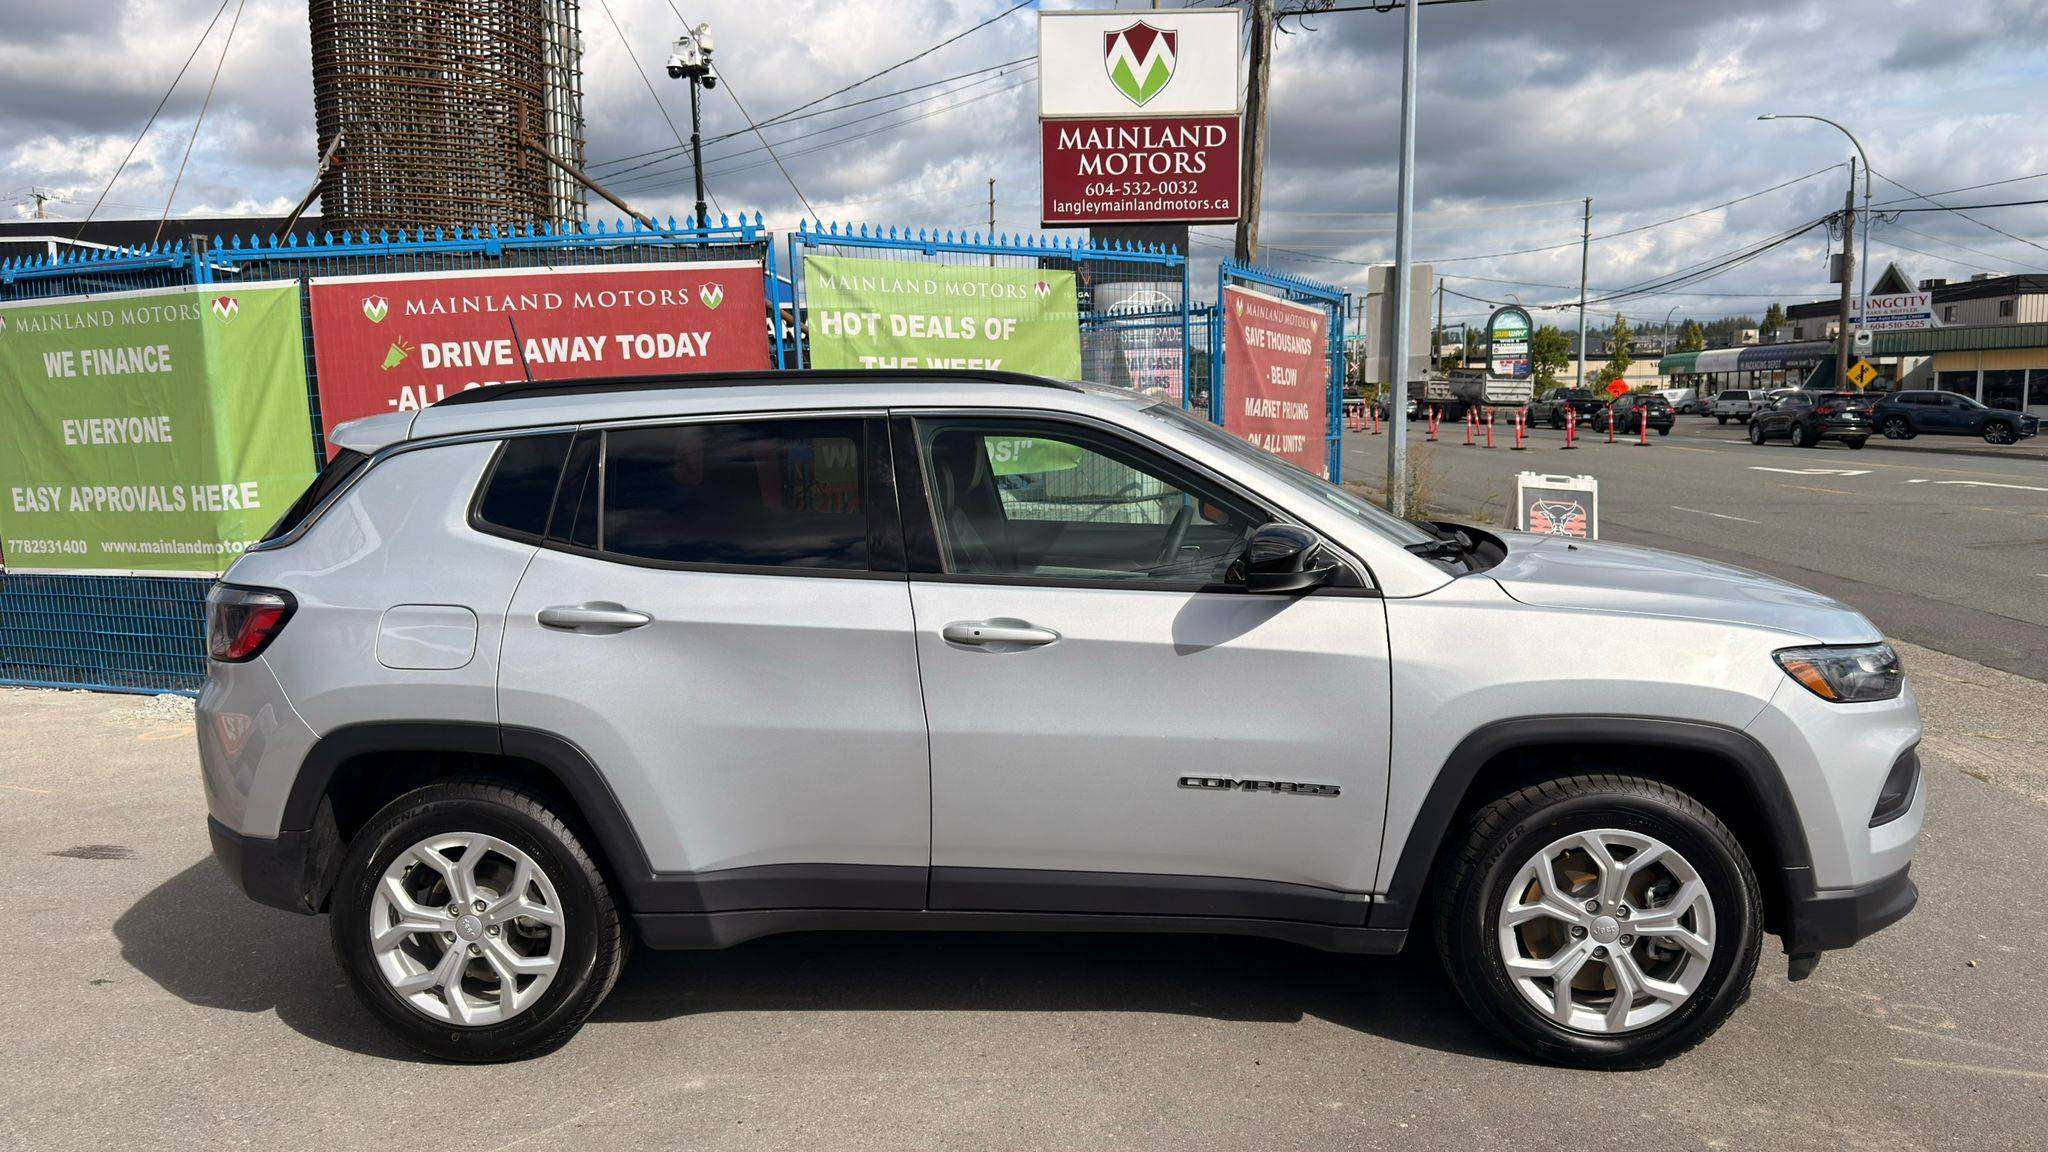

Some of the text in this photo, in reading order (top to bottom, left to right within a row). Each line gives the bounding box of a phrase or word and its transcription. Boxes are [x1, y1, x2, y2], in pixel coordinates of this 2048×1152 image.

[1057, 125, 1227, 150] MAINLAND
[1077, 151, 1207, 176] MOTORS
[1085, 180, 1198, 196] 604-532-0032
[1053, 198, 1229, 214] langleymainlandmotors.ca
[819, 275, 1028, 299] MAINLAND MOTORS
[404, 288, 690, 316] MAINLAND MOTORS
[15, 303, 200, 333] MAINLAND MOTORS
[820, 311, 881, 336] HOT
[889, 314, 976, 339] DEALS
[984, 317, 1016, 341] OF
[1246, 303, 1310, 329] MAINLAND MOTORS
[420, 332, 712, 369] DRIVE AWAY TODAY
[1245, 326, 1312, 355] SAVE THOUSANDS
[43, 345, 173, 378] WE FINANCE
[1245, 398, 1309, 421] MARKET PRICING
[62, 416, 173, 445] EVERYONE
[1247, 433, 1262, 447] ON
[1263, 434, 1281, 453] ALL
[11, 481, 260, 512] EASY APPROVALS HERE
[8, 539, 259, 554] 7782931400 www.mainlandmotor
[1177, 776, 1342, 797] COMPASS
